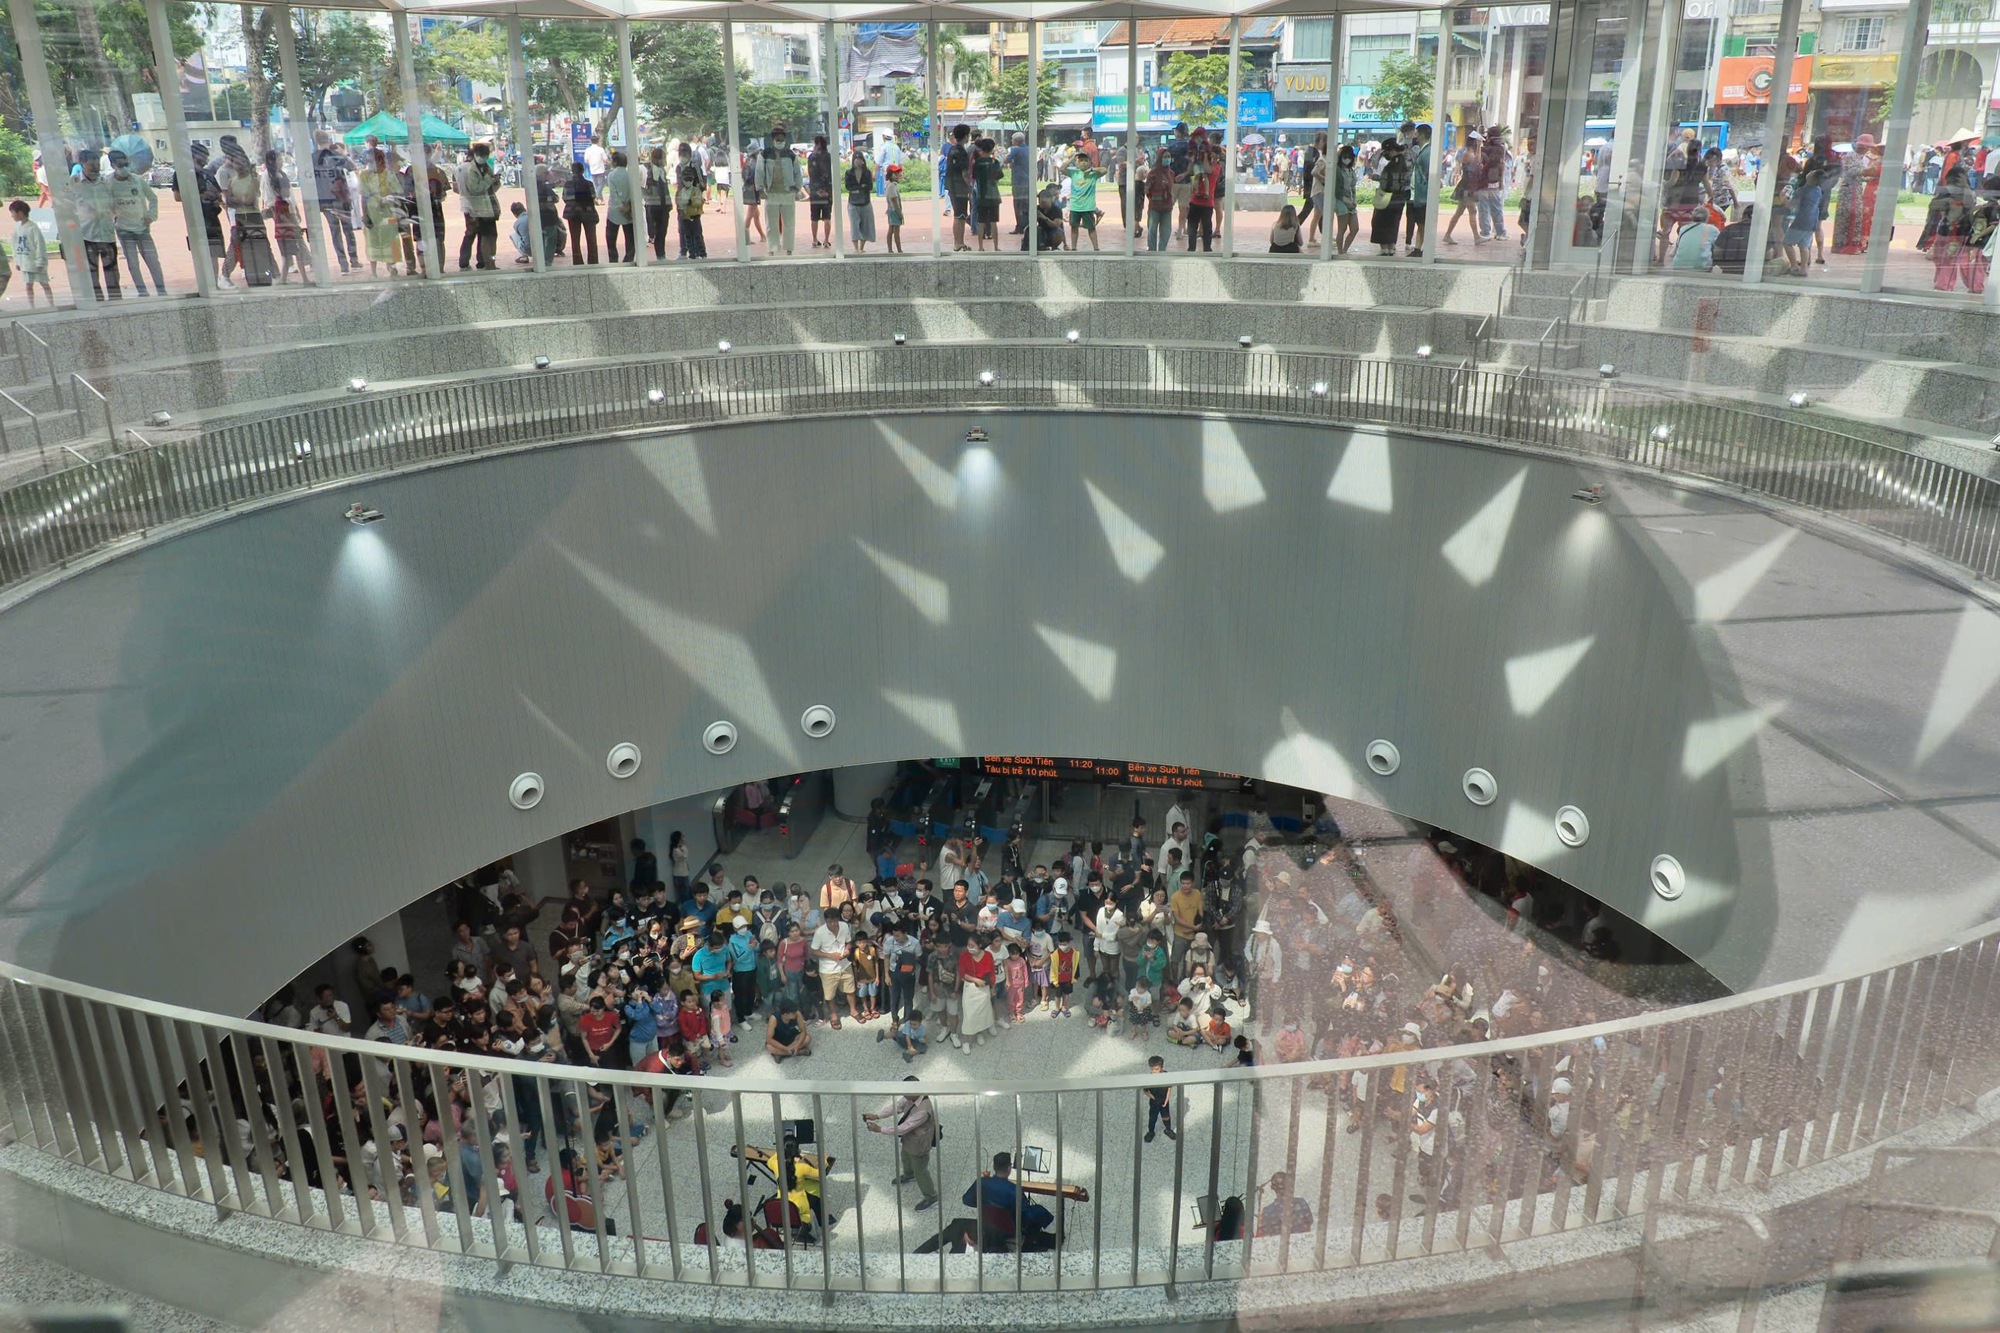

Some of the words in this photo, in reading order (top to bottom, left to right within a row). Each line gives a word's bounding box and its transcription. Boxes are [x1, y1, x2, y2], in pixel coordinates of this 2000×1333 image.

[1284, 75, 1326, 92] YUJU
[1070, 760, 1093, 769] 11:20
[1026, 768, 1037, 776] 10
[1096, 767, 1119, 776] 11:00
[1171, 777, 1183, 785] 15
